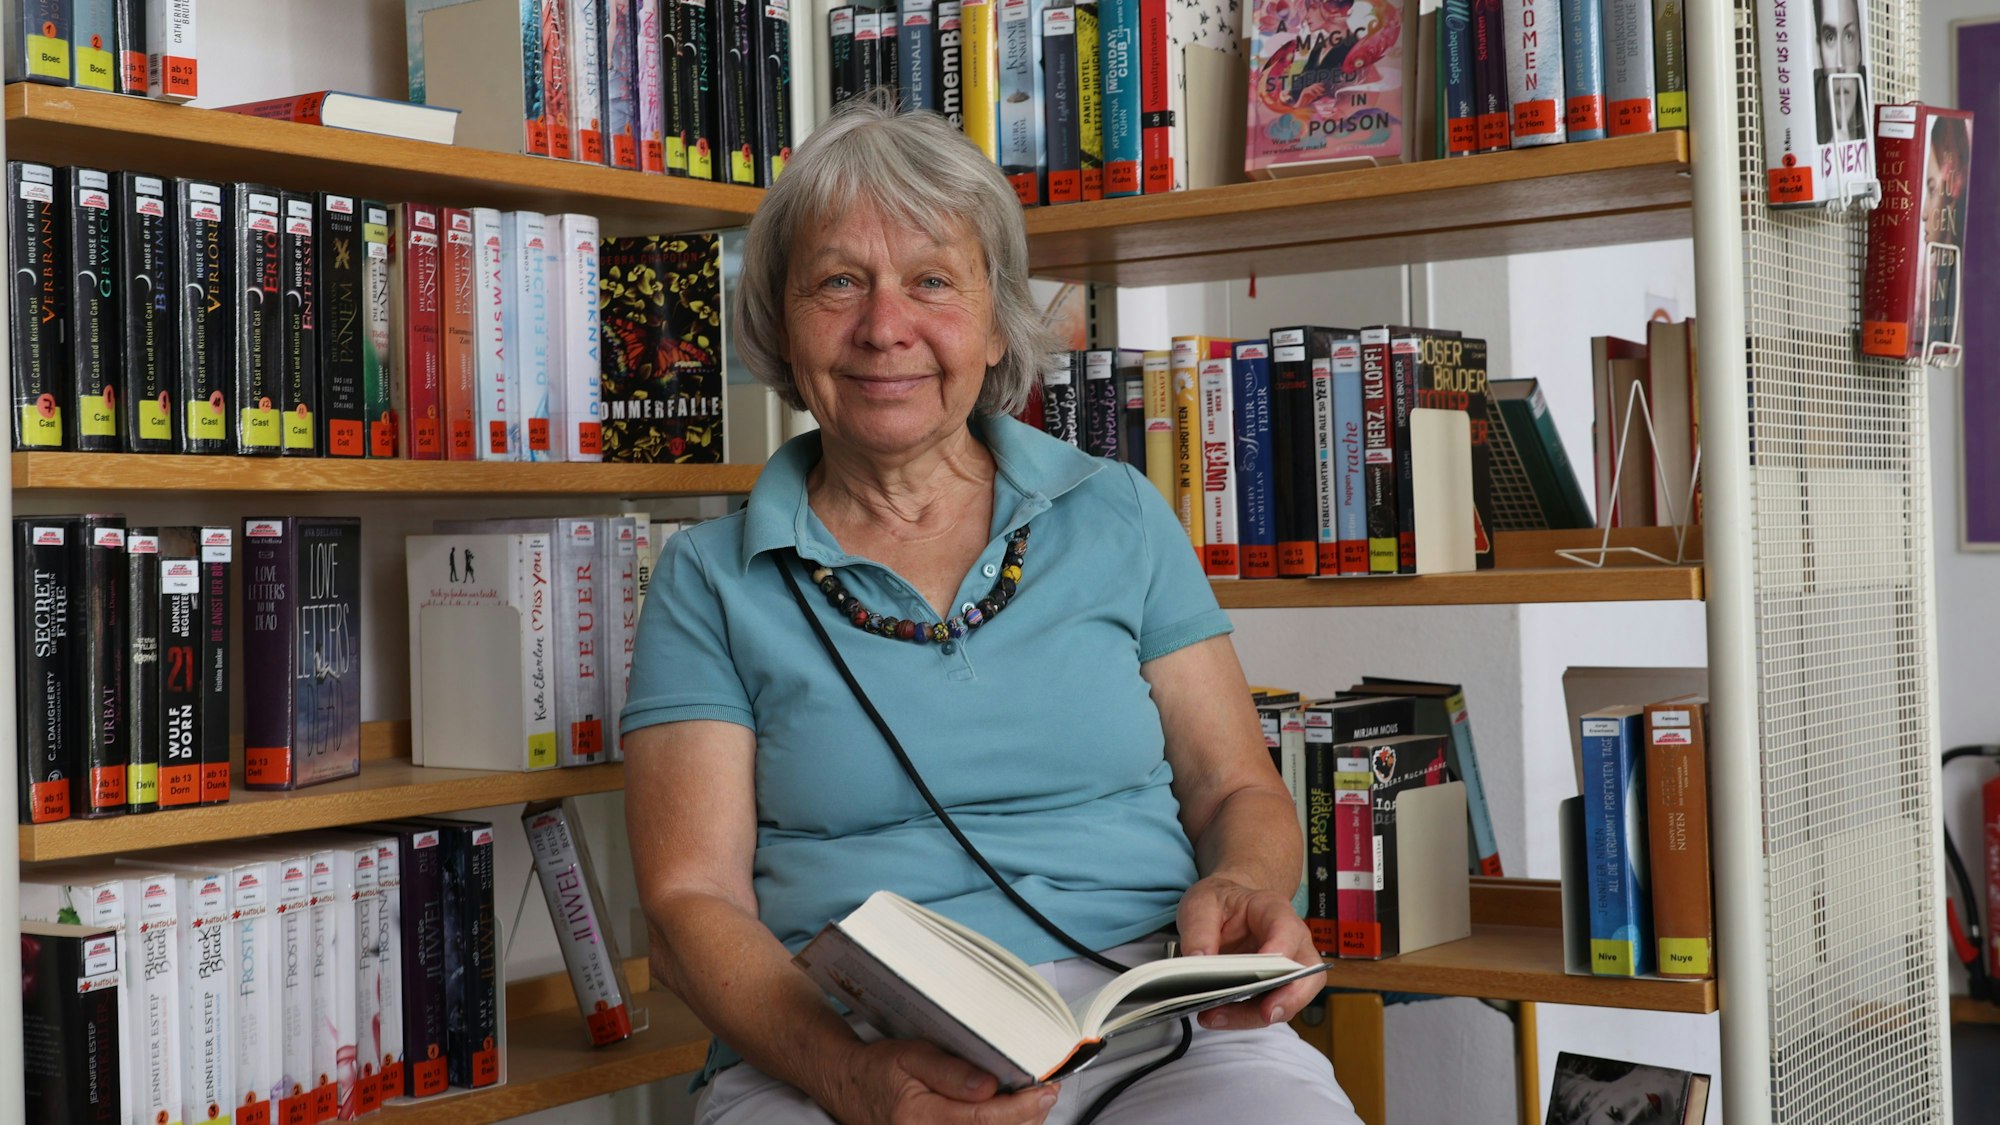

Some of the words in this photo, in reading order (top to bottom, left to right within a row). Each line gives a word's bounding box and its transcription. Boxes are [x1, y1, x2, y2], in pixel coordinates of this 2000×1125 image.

[1276, 21, 1288, 33] A
[1626, 2, 1638, 38] DOLCHE
[1296, 27, 1366, 52] MAGIC
[1478, 16, 1488, 61] Schatten
[1628, 40, 1638, 56] DER
[1776, 32, 1788, 42] IS
[42, 53, 61, 64] Boec
[1118, 42, 1128, 78] CLUB
[1450, 30, 1460, 84] September
[1777, 47, 1789, 62] US
[90, 64, 108, 75] Boec
[171, 65, 182, 73] ab
[183, 66, 193, 75] 13
[172, 76, 190, 86] Brut
[1266, 69, 1358, 93] STEEPED
[1617, 67, 1626, 83] DIE
[1778, 66, 1790, 84] OF
[1351, 94, 1367, 106] IN
[1660, 106, 1682, 115] Lupa
[1780, 88, 1791, 115] ONE
[1120, 110, 1128, 136] KUHN
[1308, 112, 1389, 136] POISON
[1821, 148, 1832, 178] IS
[28, 222, 36, 232] OF
[88, 222, 96, 234] OF
[144, 226, 152, 238] OF
[28, 236, 36, 264] HOUSE
[89, 238, 97, 266] HOUSE
[196, 238, 204, 248] OF
[256, 242, 264, 254] OF
[295, 248, 303, 258] OF
[196, 252, 205, 278] HOUSE
[256, 256, 264, 282] HOUSE
[296, 260, 304, 288] HOUSE
[30, 297, 38, 314] Cast
[90, 298, 98, 316] Cast
[197, 306, 206, 322] Cast
[30, 317, 40, 342] Kristin
[90, 318, 99, 342] Kristin
[252, 310, 260, 326] Cast
[293, 314, 302, 329] Cast
[146, 322, 154, 346] Kristin
[198, 326, 206, 349] Kristin
[252, 328, 261, 352] Kristin
[294, 331, 302, 354] Kristin
[32, 344, 40, 358] und
[198, 351, 206, 364] und
[1416, 336, 1462, 366] BÖSER
[31, 360, 40, 378] Cast
[91, 360, 100, 378] Cast
[198, 366, 208, 384] Cast
[253, 370, 262, 386] Cast
[536, 346, 546, 386] DIE
[1364, 348, 1384, 399] KLOPF!
[294, 372, 302, 388] Cast
[496, 373, 506, 412] DIE
[590, 376, 599, 416] DIE
[94, 413, 110, 422] Cast
[1258, 386, 1268, 432] FEDER
[38, 419, 56, 428] Cast
[151, 417, 167, 426] Cast
[201, 417, 218, 426] Cast
[252, 418, 270, 427] Cast
[292, 426, 308, 435] Cast
[1178, 406, 1189, 460] SCHRITTEN
[1180, 464, 1190, 474] 10
[1320, 460, 1330, 494] MARTIN
[1180, 478, 1190, 488] IN
[1256, 472, 1265, 536] MACMILLAN
[1370, 550, 1394, 558] Hamm
[255, 565, 278, 582] LOVE
[310, 542, 339, 600] LOVE
[531, 552, 548, 587] You
[211, 580, 223, 595] DER
[248, 582, 285, 601] LETTERS
[34, 569, 51, 658] SECRET
[56, 586, 67, 637] FIRE
[172, 595, 180, 634] DUNKLE
[212, 597, 223, 626] ANGST
[256, 613, 278, 632] DEAD
[531, 590, 544, 632] Miss
[577, 562, 595, 679] FEUER
[212, 628, 223, 642] DIE
[296, 602, 350, 679] LETTERS
[167, 646, 193, 692] 21
[532, 636, 546, 690] Eberlen
[48, 672, 56, 740] DAUGHERTY
[103, 686, 115, 745] URBAT
[534, 690, 547, 720] Kate
[306, 680, 344, 757] DEAD
[169, 708, 180, 758] WULF
[181, 704, 193, 758] DORN
[1354, 726, 1380, 738] MIRJAM
[1380, 724, 1400, 735] MOUS
[1602, 737, 1613, 756] TAGE
[170, 774, 180, 783] ab
[182, 774, 192, 782] 13
[206, 781, 228, 790] Dunk
[218, 769, 228, 778] 13
[170, 786, 190, 794] Dorn
[1603, 762, 1616, 810] PERFEKTEN
[1310, 788, 1322, 854] PARADISE
[1319, 790, 1332, 852] PROJECT
[1676, 812, 1686, 851] NUYEN
[1605, 814, 1617, 858] VERDAMMT
[1608, 862, 1618, 876] DIE
[1609, 880, 1618, 893] ALL
[198, 928, 212, 979] Black
[1598, 953, 1617, 962] Nive
[1670, 953, 1693, 963] Nuye
[581, 965, 595, 991] AMY
[588, 952, 609, 998] EWING
[150, 994, 160, 1036] ESTEP
[204, 992, 214, 1034] ESTEP
[88, 1022, 97, 1053] ESTEP
[89, 1056, 98, 1104] JENNIFER
[152, 1040, 162, 1107] JENNIFER
[205, 1040, 215, 1104] JENNIFER
